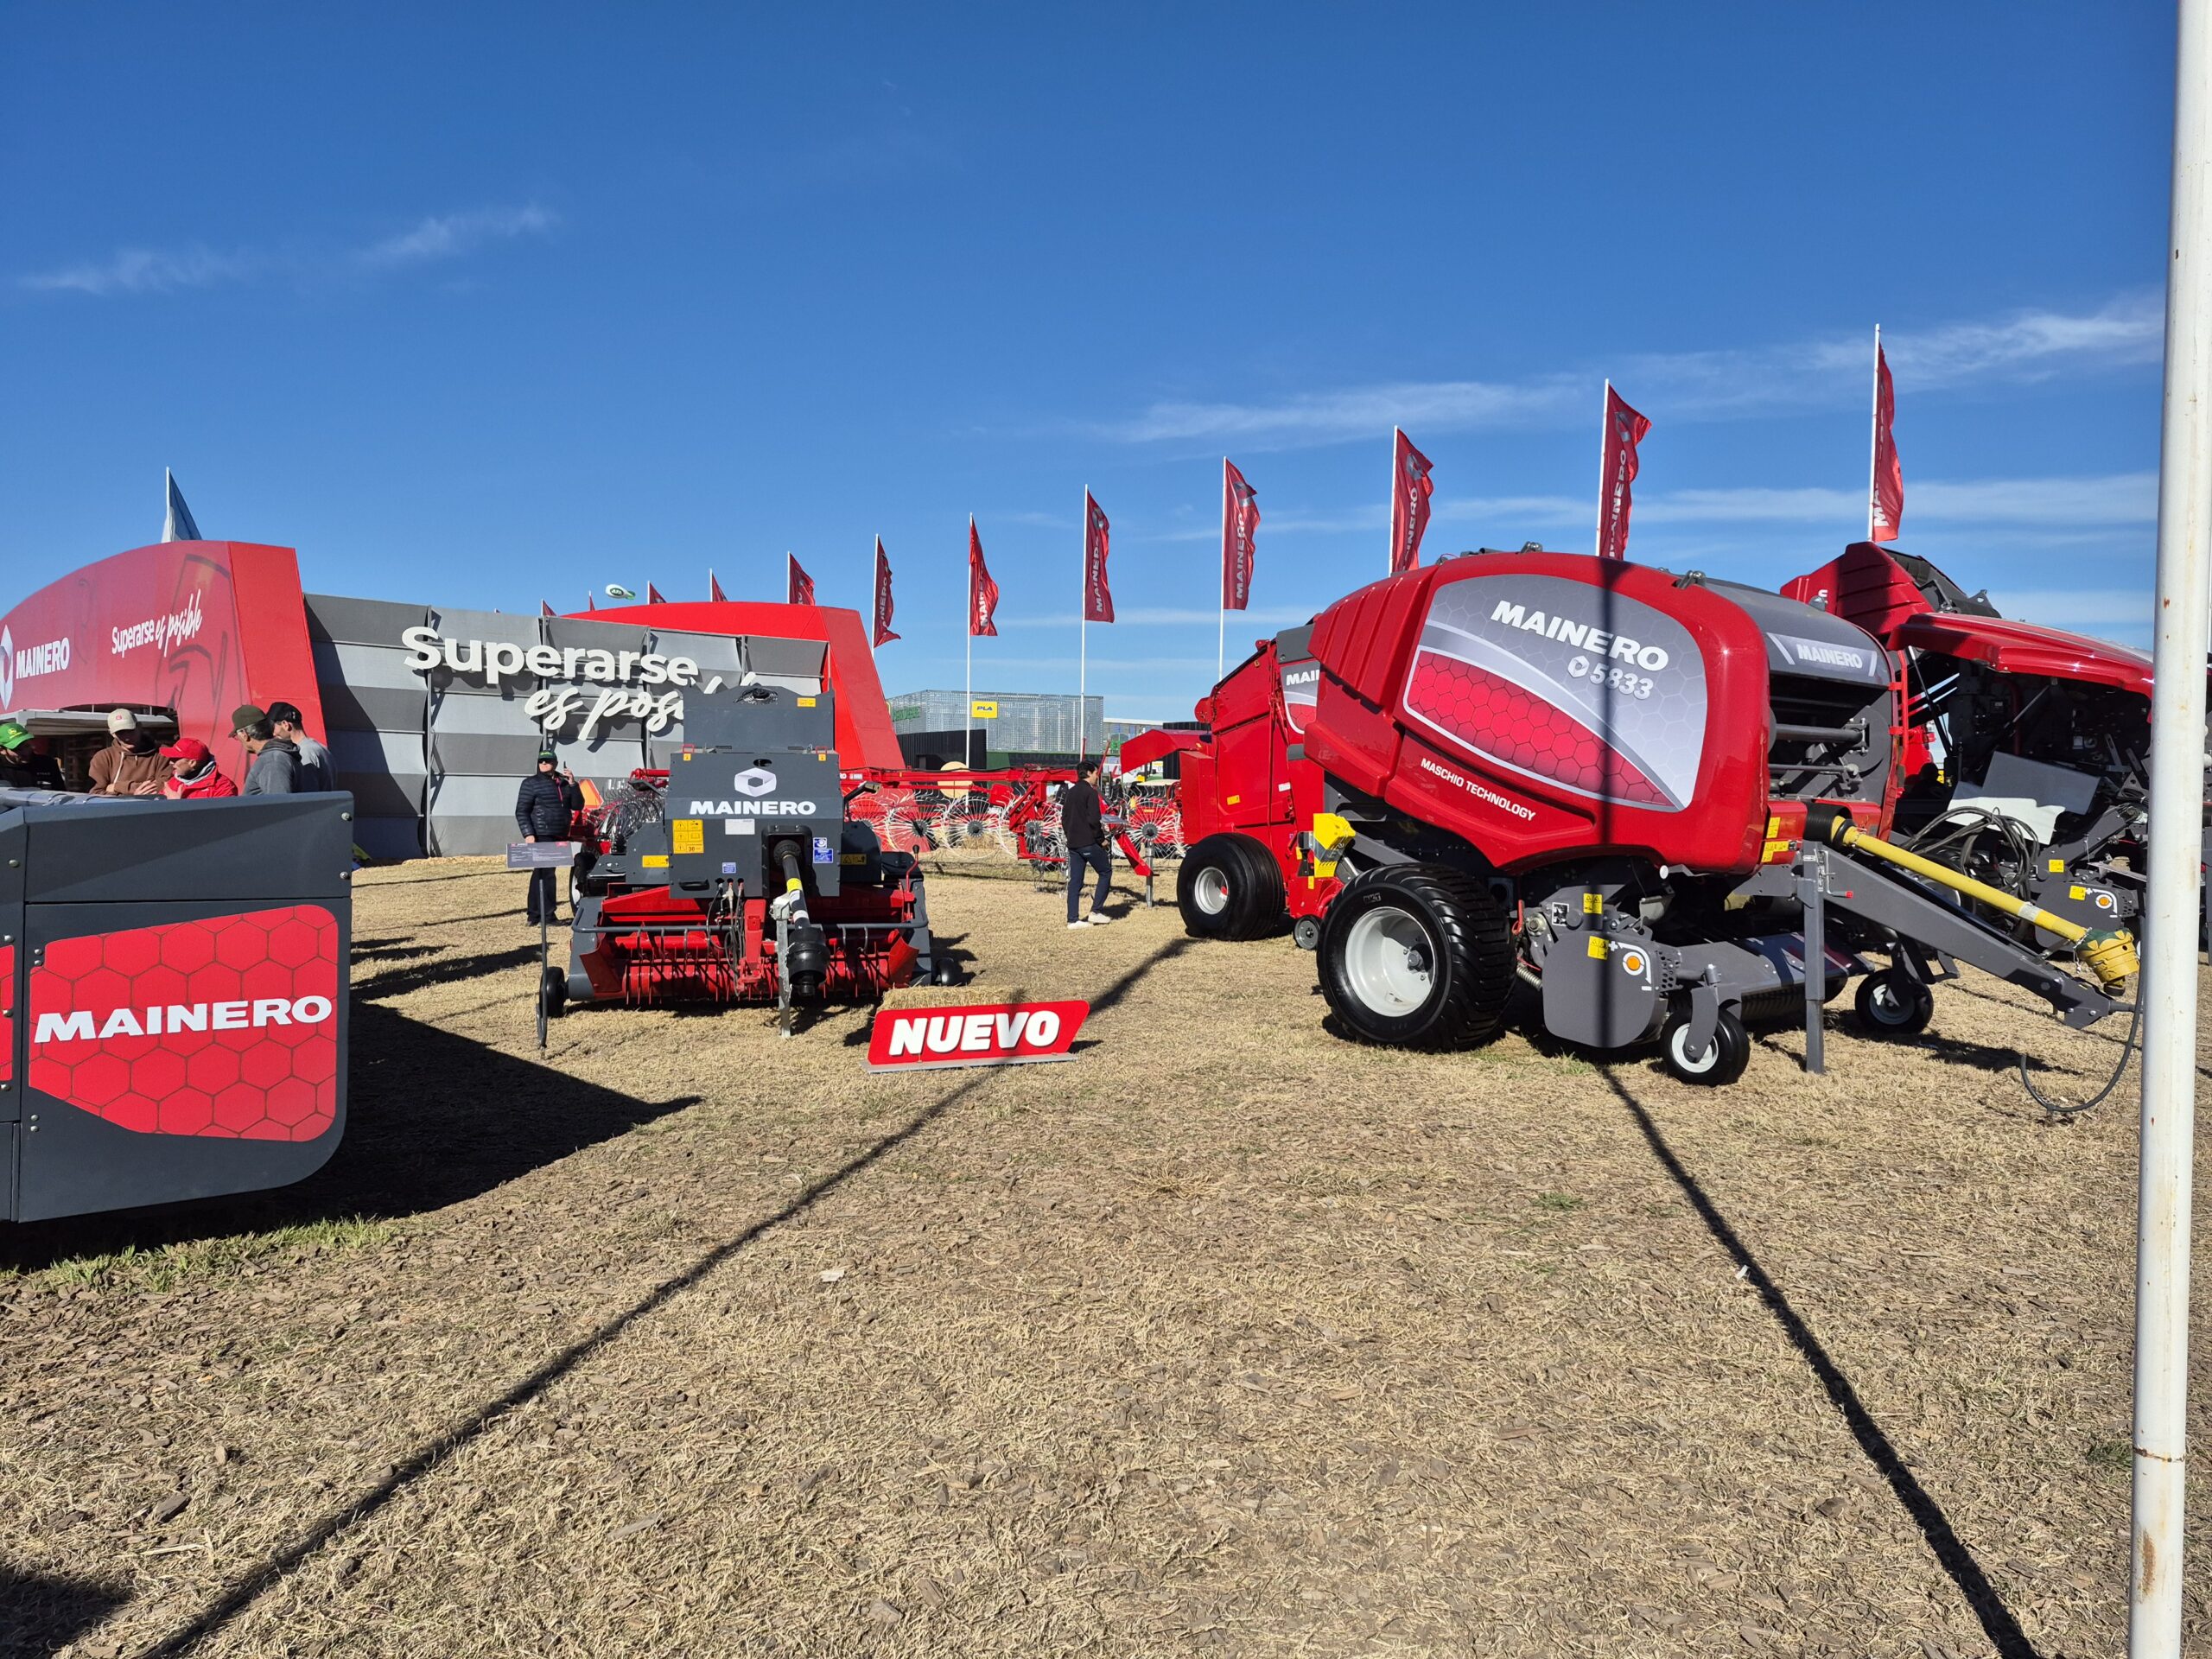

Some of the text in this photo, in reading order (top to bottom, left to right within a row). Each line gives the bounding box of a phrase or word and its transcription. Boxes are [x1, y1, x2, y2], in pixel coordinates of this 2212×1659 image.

[1403, 486, 1418, 570] INERO
[111, 588, 202, 658] Superarse es posible
[1491, 600, 1669, 671] MAINERO
[16, 637, 70, 679] MAINERO
[400, 626, 699, 686] Superarse
[1796, 644, 1863, 669] MAINERO
[1589, 662, 1654, 700] 5833
[524, 686, 584, 731] es
[690, 801, 817, 815] MAINERO
[1421, 758, 1536, 822] MASCHIO TECHNOLOGY
[34, 995, 333, 1044] MAINERO
[888, 1010, 1060, 1056] NUEVO
